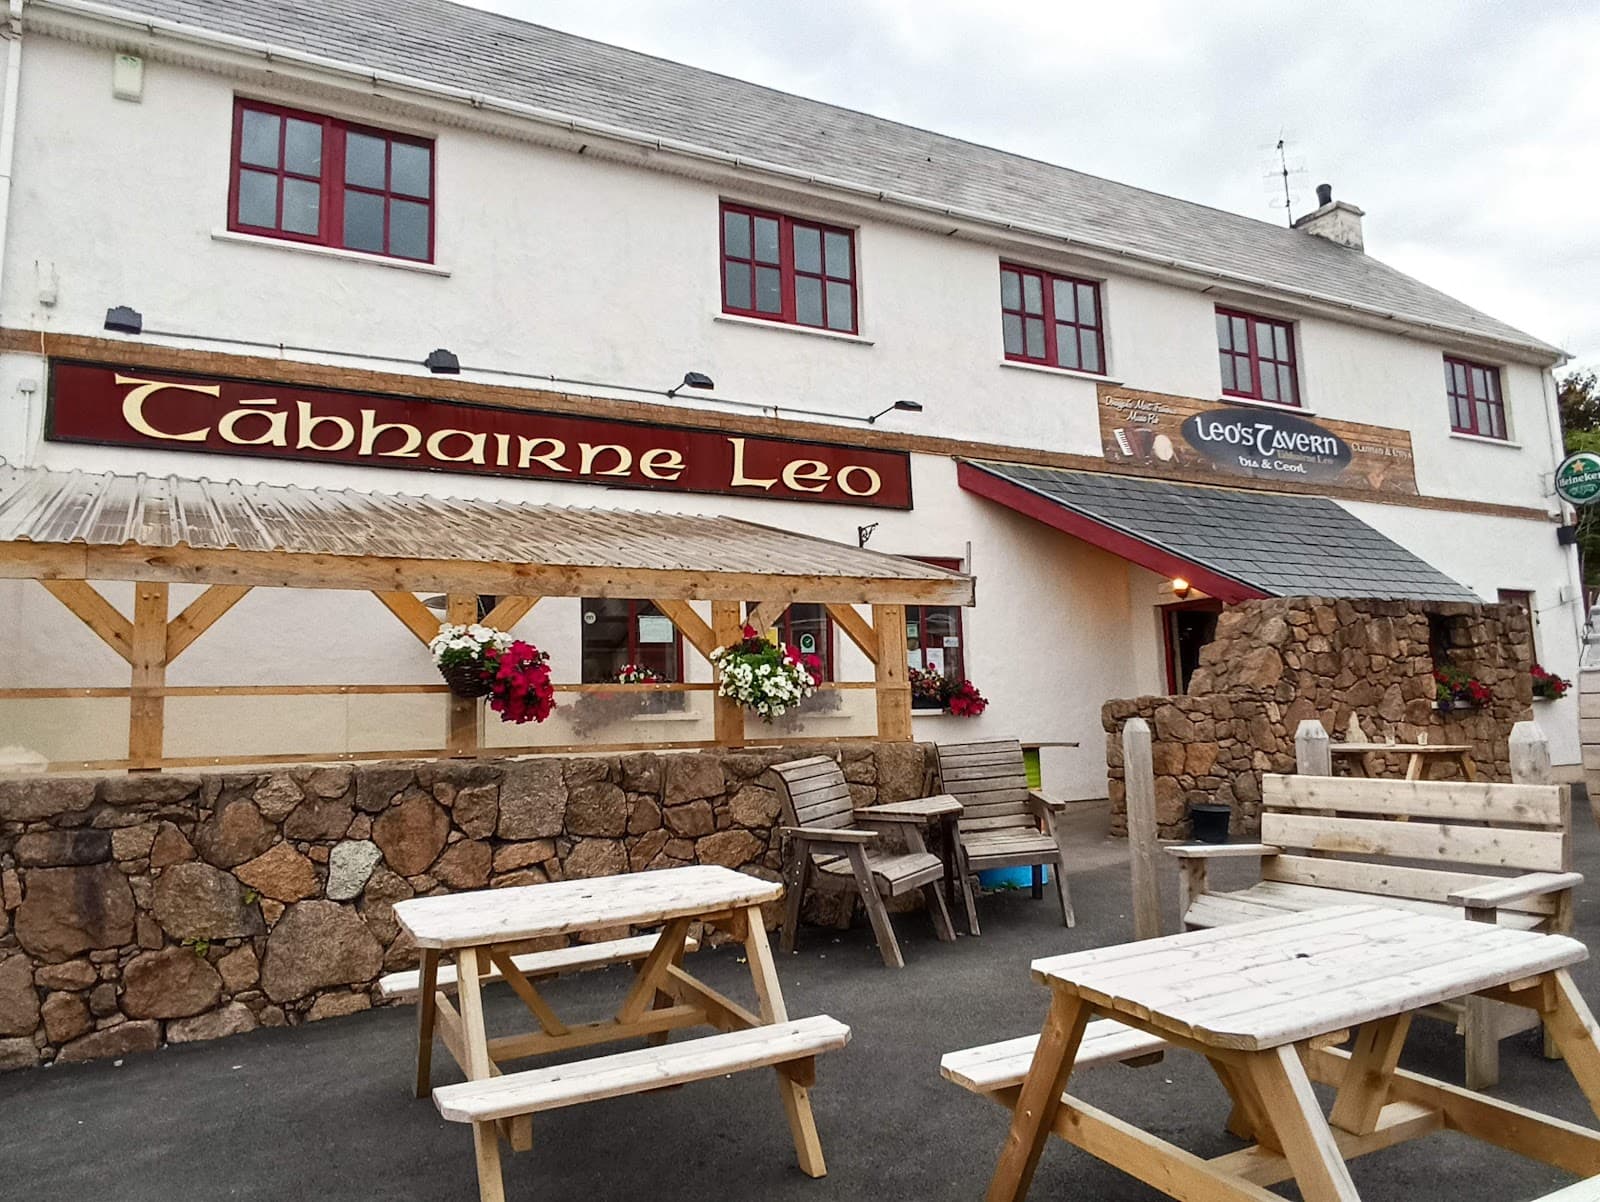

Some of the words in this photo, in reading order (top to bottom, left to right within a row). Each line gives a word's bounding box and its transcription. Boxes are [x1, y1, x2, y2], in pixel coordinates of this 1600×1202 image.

[1195, 416, 1254, 446] Leo's
[1254, 424, 1338, 456] Tavern
[728, 438, 882, 496] Leo
[1261, 459, 1272, 469] &
